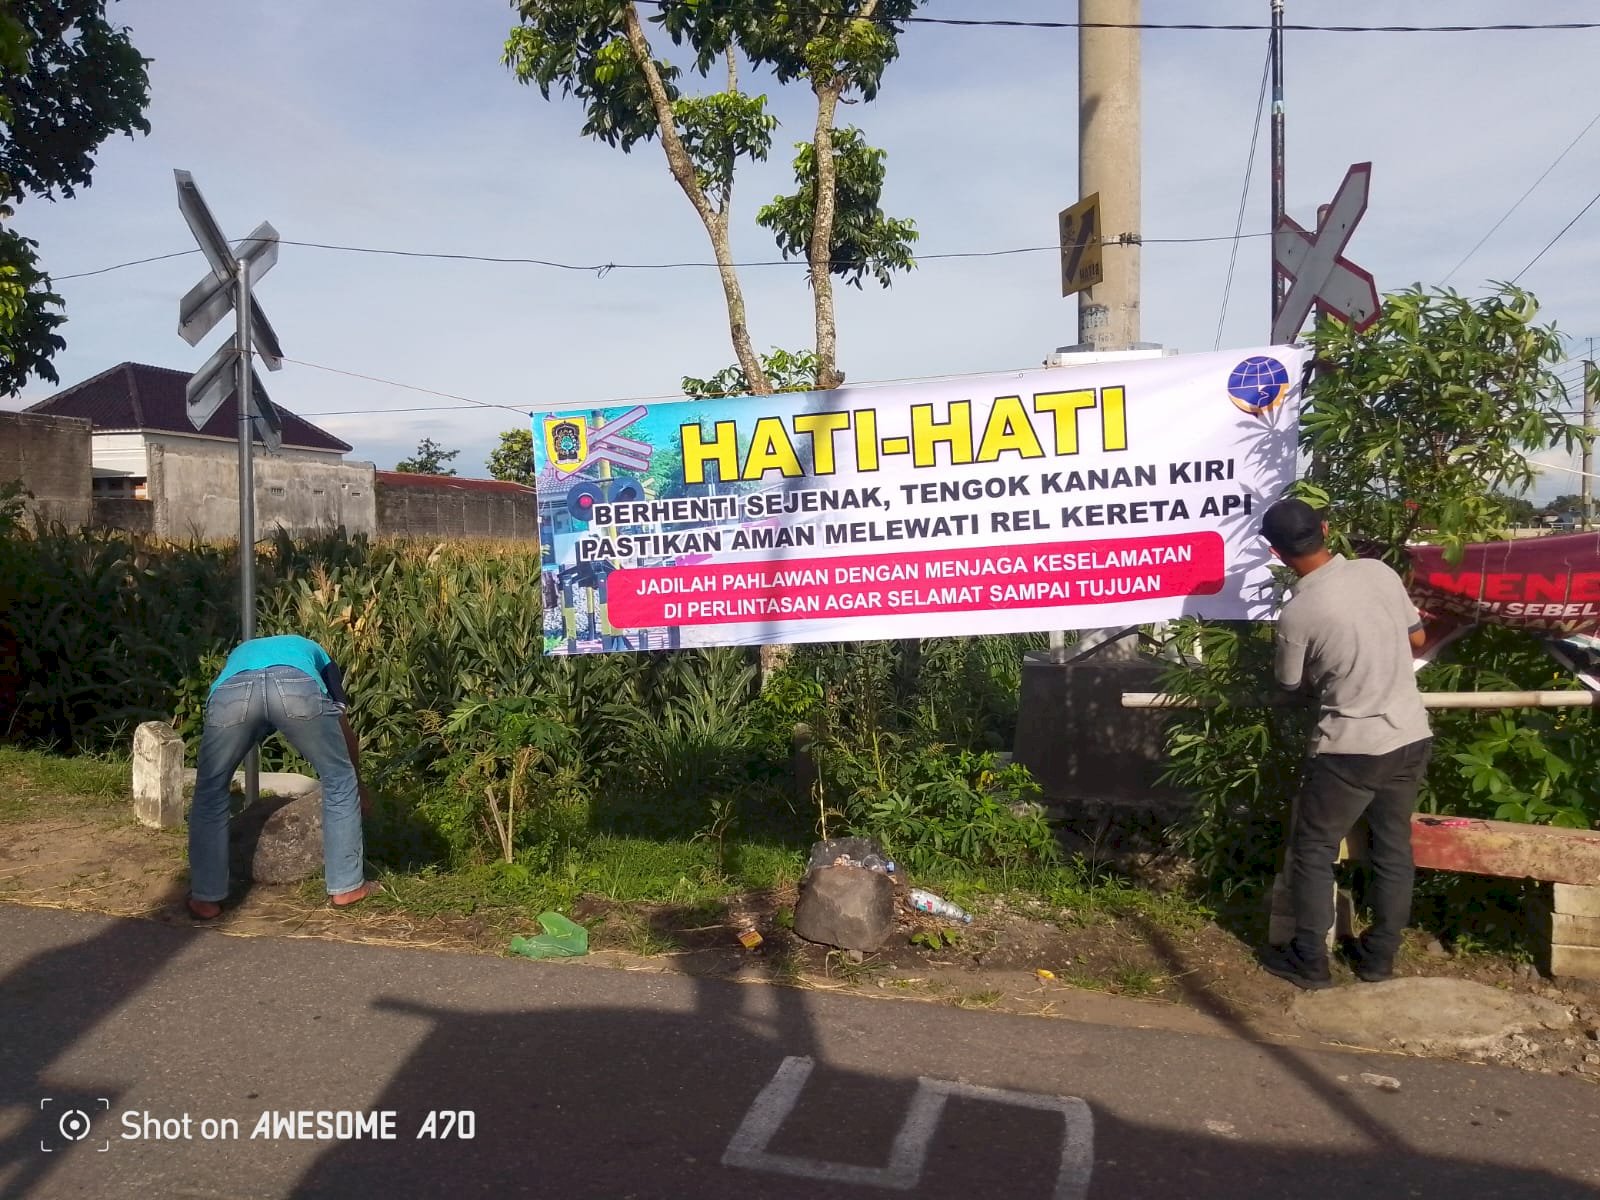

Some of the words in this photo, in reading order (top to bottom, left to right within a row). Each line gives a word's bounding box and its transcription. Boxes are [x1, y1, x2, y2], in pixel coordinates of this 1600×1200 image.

[680, 385, 1128, 485] HATI-HATI
[595, 497, 737, 526] BERHENTI
[747, 486, 891, 517] SEJENAK,
[900, 473, 1031, 505] TENGOK
[1041, 464, 1157, 495] KANAN
[1169, 458, 1235, 486] KIRI
[581, 530, 722, 560] PASTIKAN
[731, 525, 815, 551] AMAN
[825, 514, 980, 545] MELEWATI
[991, 507, 1051, 534] REL
[1061, 498, 1190, 529] KERETA
[1199, 493, 1253, 520] API
[636, 576, 715, 596] JADILAH
[722, 568, 830, 592] PAHLAWAN
[835, 562, 919, 586] DENGAN
[925, 556, 1029, 580] MENJAGA
[1033, 545, 1193, 573] KESELAMATAN
[663, 603, 682, 619] DI
[688, 596, 821, 619] PERLINTASAN
[825, 592, 882, 612] AGAR
[887, 585, 984, 608] SELAMAT
[990, 580, 1071, 603] SAMPAI
[1076, 574, 1162, 598] TUJUAN
